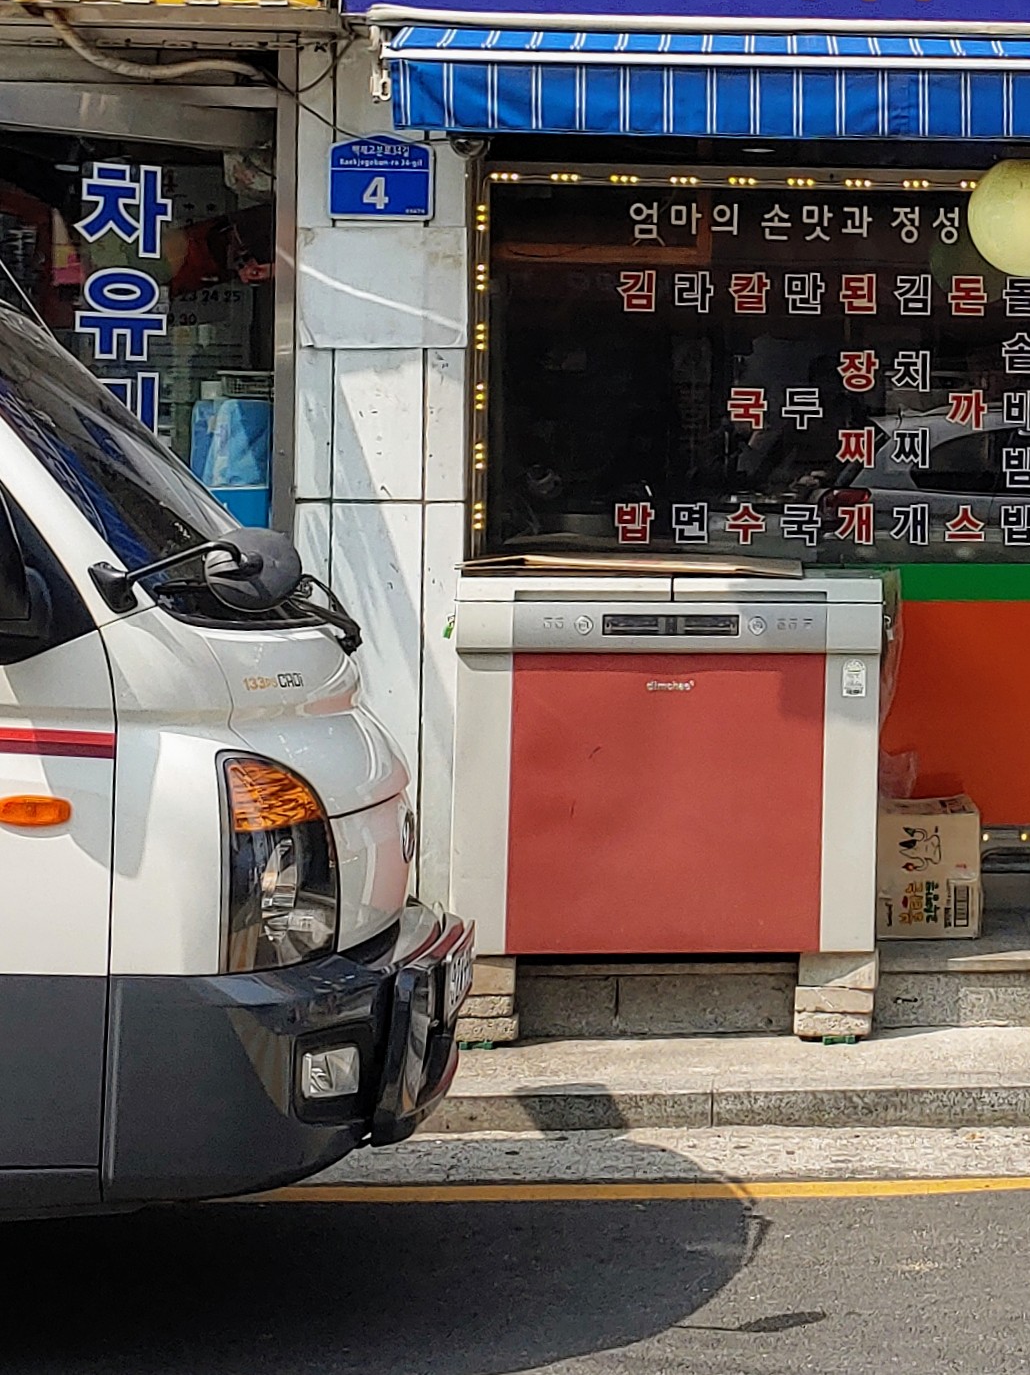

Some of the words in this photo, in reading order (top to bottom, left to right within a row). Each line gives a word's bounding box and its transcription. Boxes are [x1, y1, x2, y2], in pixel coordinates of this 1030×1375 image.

[362, 177, 389, 210] 4
[629, 202, 740, 240] 엄마의
[761, 203, 874, 241] 손맛과
[891, 204, 961, 244] 정성
[725, 272, 770, 545] 칼국수
[780, 272, 826, 546] 만두국
[835, 273, 879, 546] 된장찌개
[890, 274, 933, 546] 김치찌개
[944, 275, 988, 543] 돈까스
